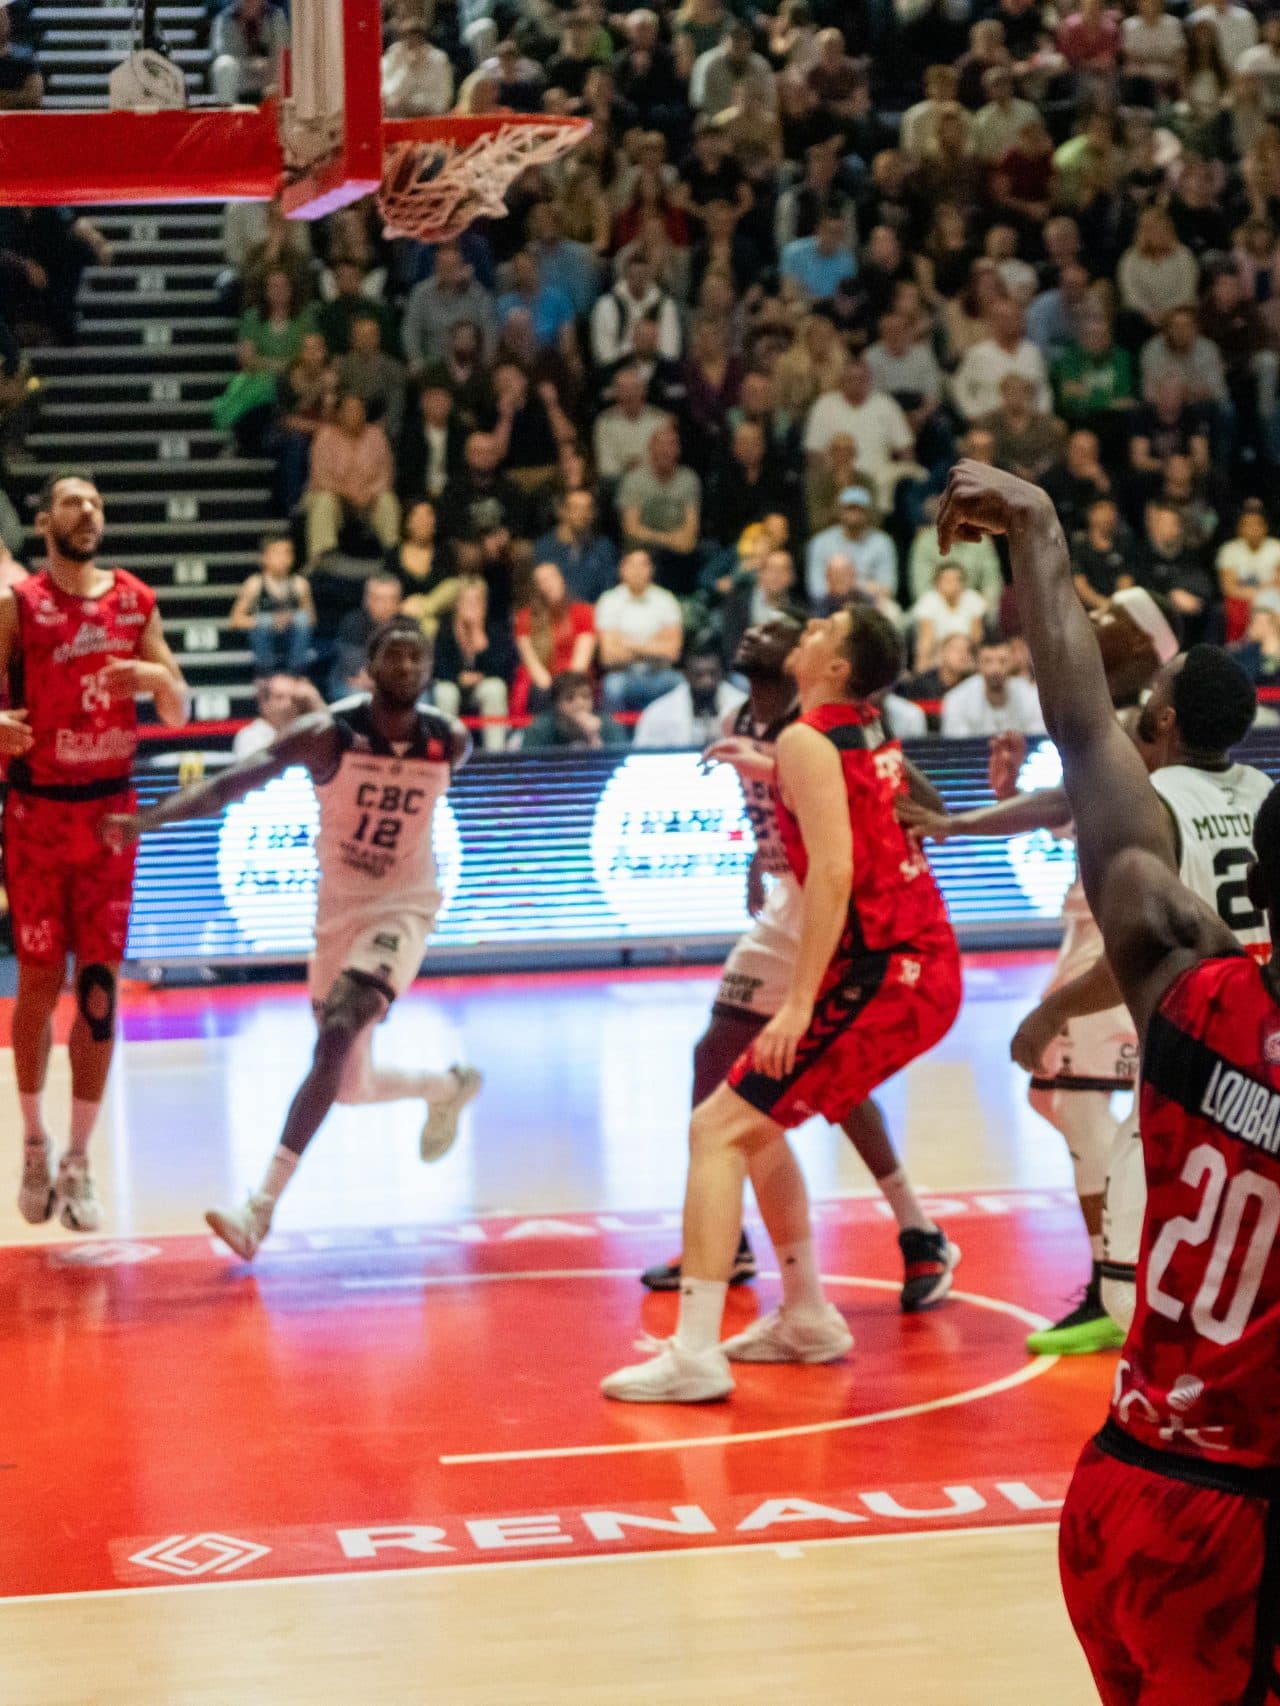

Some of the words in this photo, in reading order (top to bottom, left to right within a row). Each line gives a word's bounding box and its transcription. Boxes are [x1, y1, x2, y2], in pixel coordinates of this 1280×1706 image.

[357, 783, 425, 815] CBC
[353, 813, 402, 849] 12
[1192, 813, 1251, 841] MUTU
[334, 1480, 1066, 1559] RENAUL
